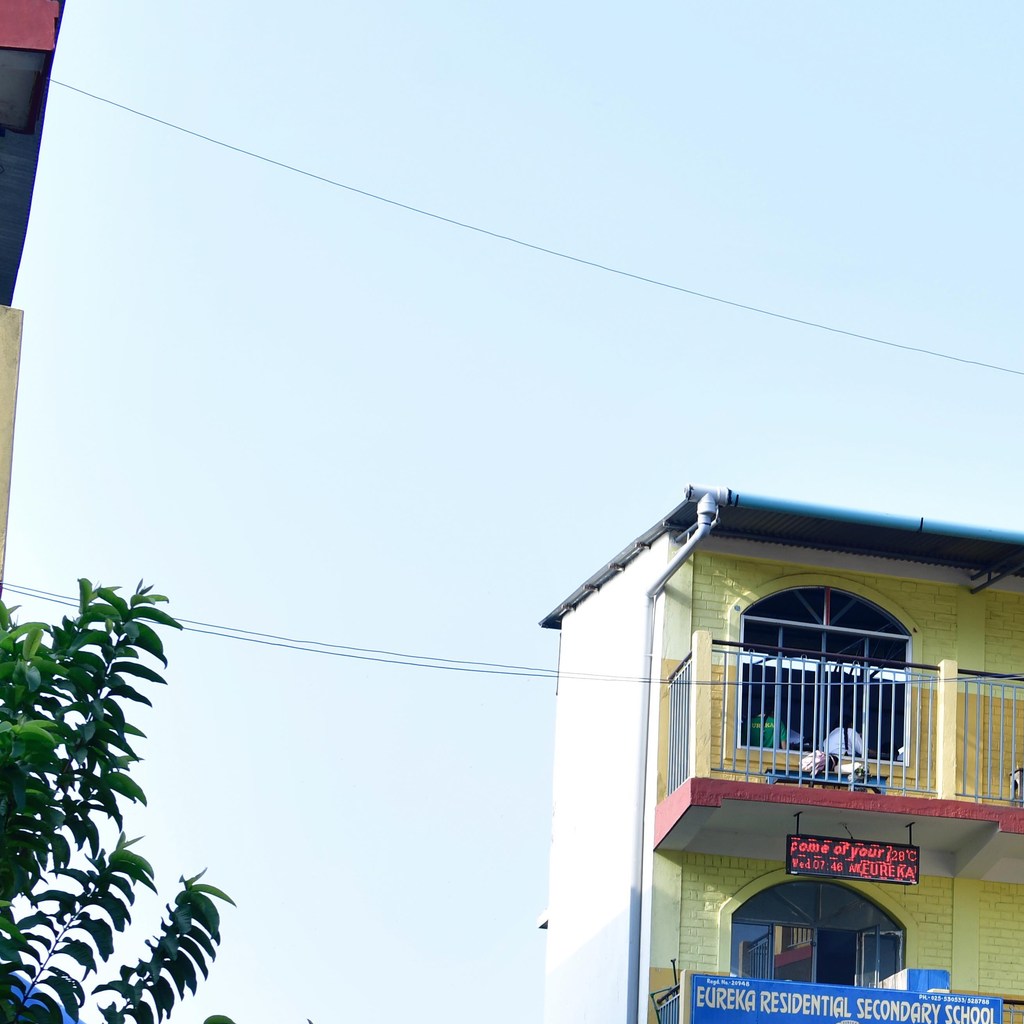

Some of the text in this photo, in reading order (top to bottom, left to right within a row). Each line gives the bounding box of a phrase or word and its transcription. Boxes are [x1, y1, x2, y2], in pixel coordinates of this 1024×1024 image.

[792, 858, 811, 869] Wed
[862, 863, 915, 878] EUREKA
[696, 985, 756, 1013] EUREKA
[760, 990, 852, 1019] RESIDENTIAL
